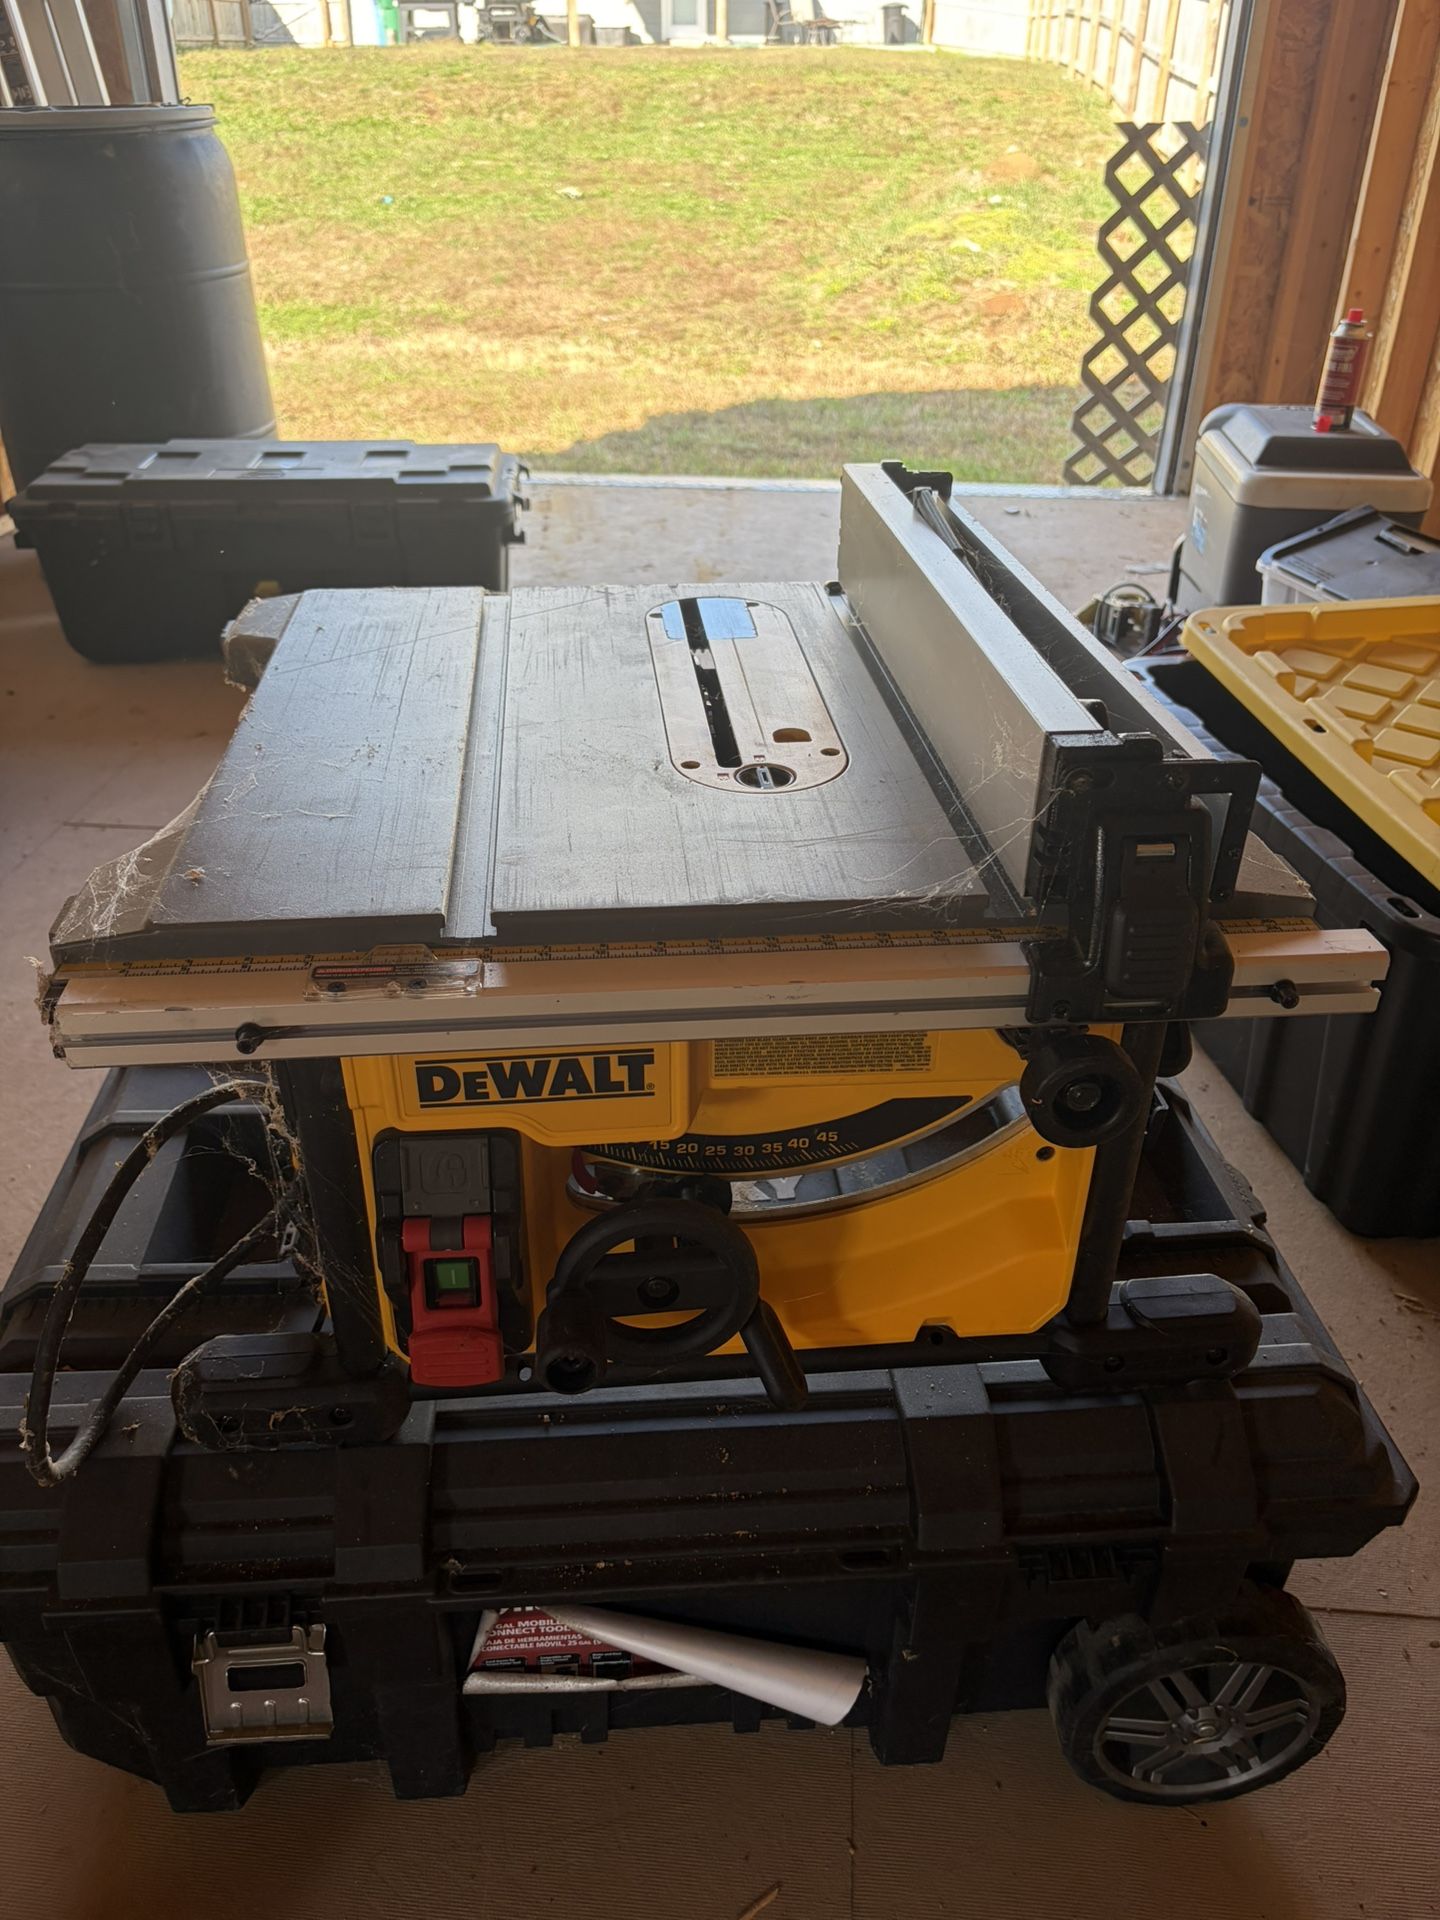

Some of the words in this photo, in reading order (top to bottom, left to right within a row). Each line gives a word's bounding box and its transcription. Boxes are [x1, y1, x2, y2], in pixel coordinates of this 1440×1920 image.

[415, 1053, 655, 1103] DEWALT
[650, 1140, 670, 1150] 15
[677, 1143, 698, 1154] 20
[704, 1145, 727, 1156] 25
[733, 1145, 755, 1157] 30
[762, 1143, 783, 1154] 35
[787, 1138, 810, 1149] 40
[816, 1131, 839, 1142] 45
[489, 1627, 536, 1637] ONNECT
[517, 1634, 583, 1643] HERRAMIENTAS
[481, 1642, 535, 1652] CONECTABLE
[567, 1639, 577, 1647] 25
